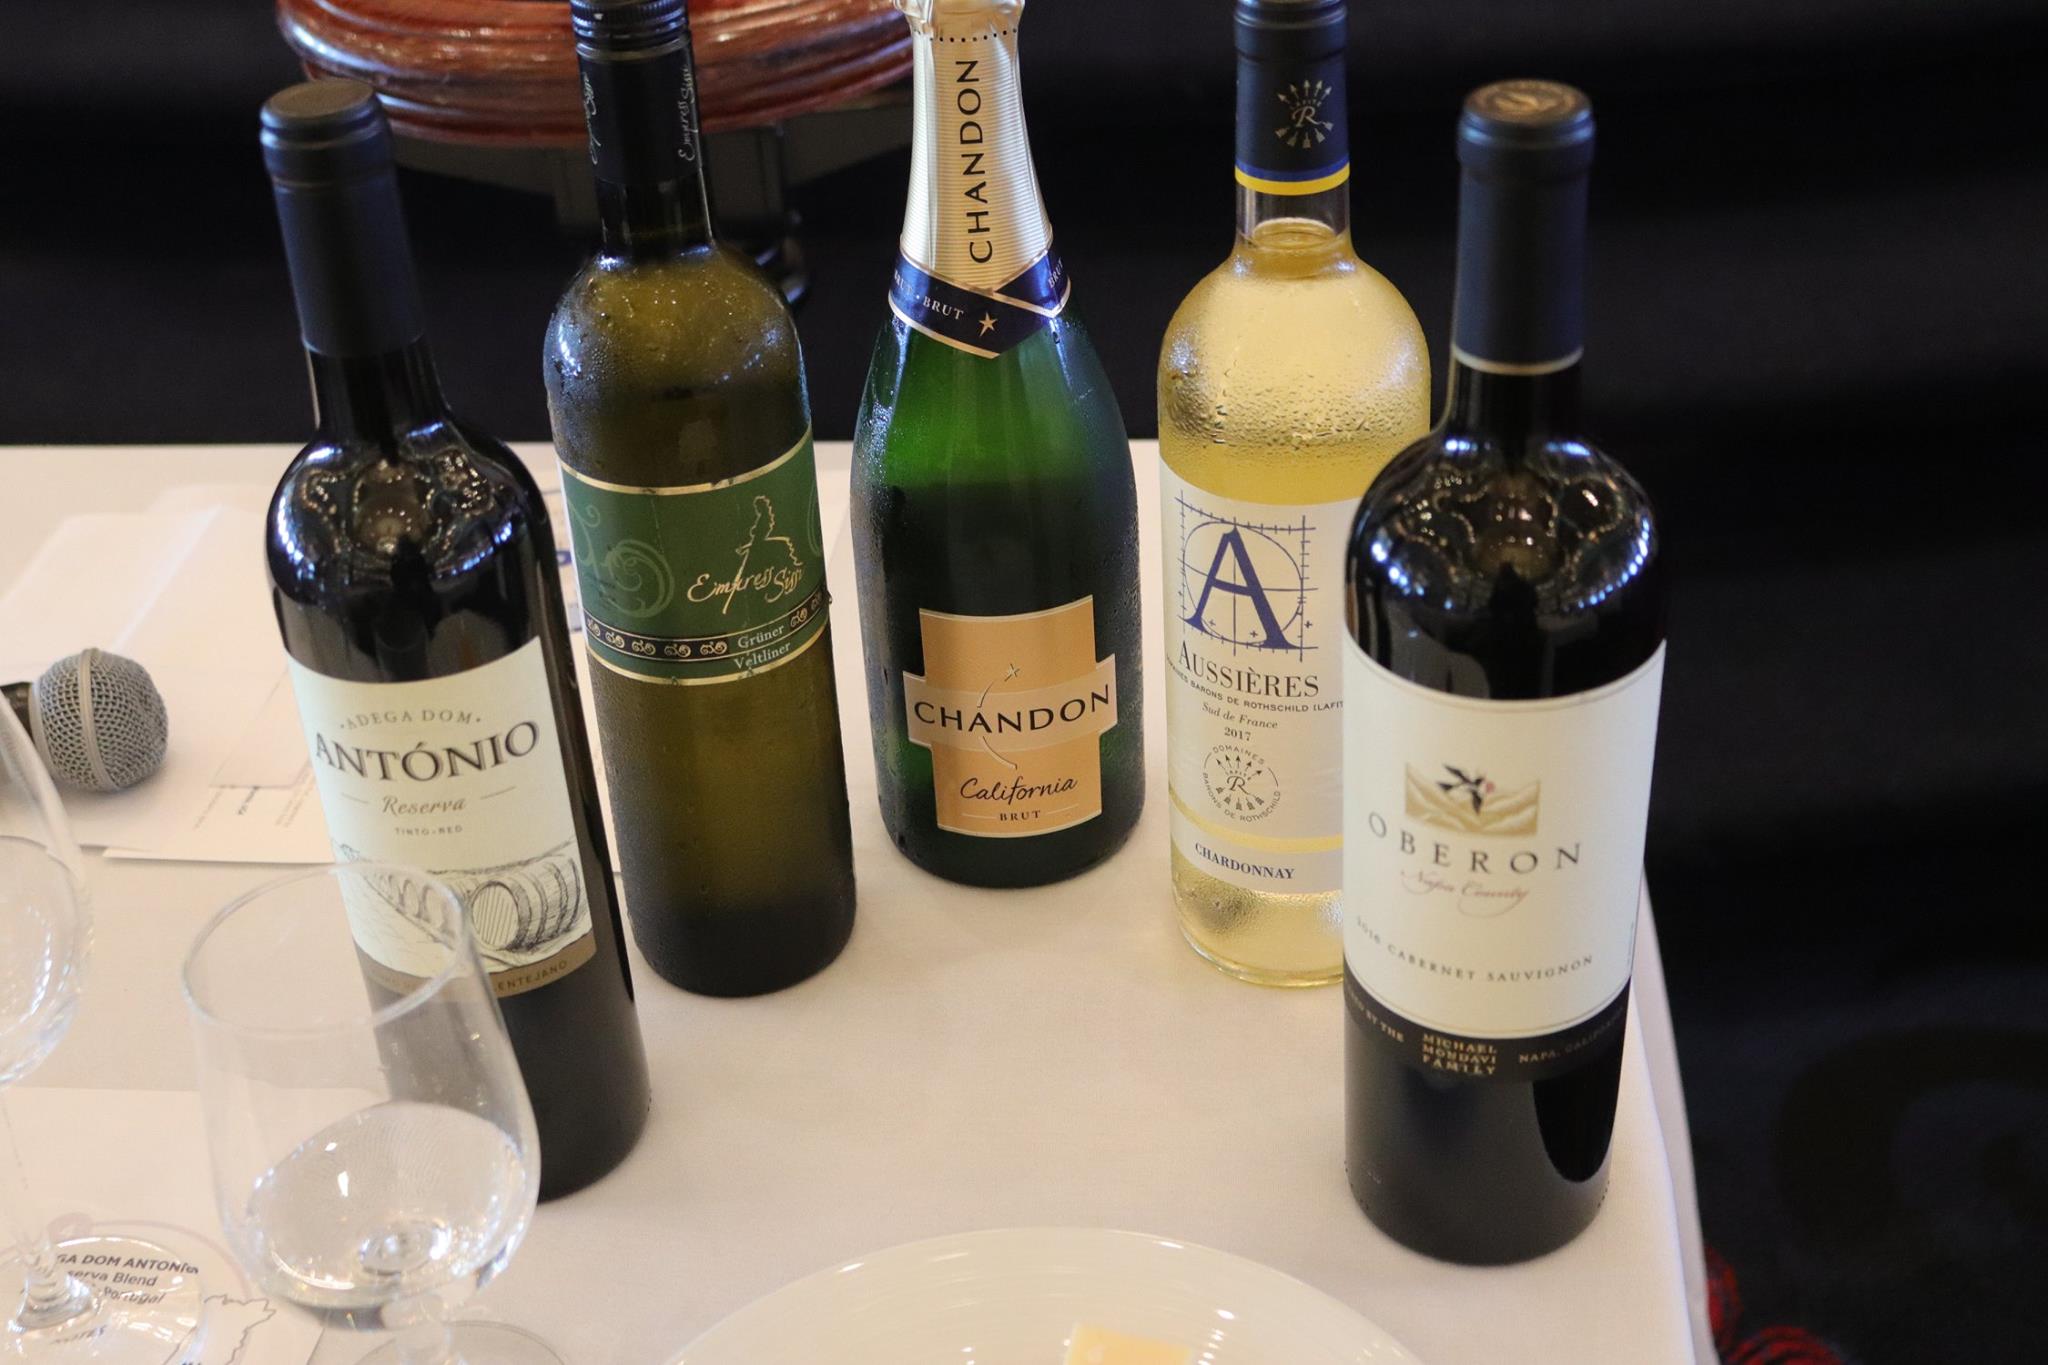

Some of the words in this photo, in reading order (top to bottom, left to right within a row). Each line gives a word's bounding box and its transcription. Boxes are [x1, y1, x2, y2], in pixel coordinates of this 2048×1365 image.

[955, 60, 993, 263] CHANDON
[1049, 257, 1064, 289] BRUT
[922, 295, 964, 321] BRUT
[1183, 527, 1300, 650] A
[737, 624, 785, 650] Grüner
[733, 641, 792, 671] Veltliner
[1179, 640, 1319, 698] AUSSIÈRES
[914, 684, 1109, 734] CHANDON
[1190, 680, 1223, 701] BARONS
[1226, 695, 1240, 706] DE
[1243, 699, 1309, 713] ROTHSCHILD
[346, 709, 412, 730] ADEGA
[419, 709, 473, 726] DOM
[1202, 701, 1221, 718] Sud
[1223, 711, 1235, 722] de
[1239, 712, 1279, 730] France
[1224, 727, 1251, 742] 2017
[316, 720, 540, 782] ANTÓNIO
[959, 776, 1078, 805] California
[381, 795, 468, 818] Reserva
[1000, 809, 1041, 822] BRUT
[1368, 810, 1581, 875] OBERON
[1195, 842, 1296, 880] CHARDONNAY
[1387, 944, 1475, 981] CABERNET
[1487, 954, 1593, 982] SAUVIGNON
[1380, 1021, 1405, 1043] THE
[1422, 1033, 1497, 1055] MICHAEL
[1422, 1043, 1497, 1064] MONDAVI
[1422, 1054, 1497, 1076] FAMILY
[81, 1254, 121, 1267] DOM
[112, 1272, 159, 1287] Blend
